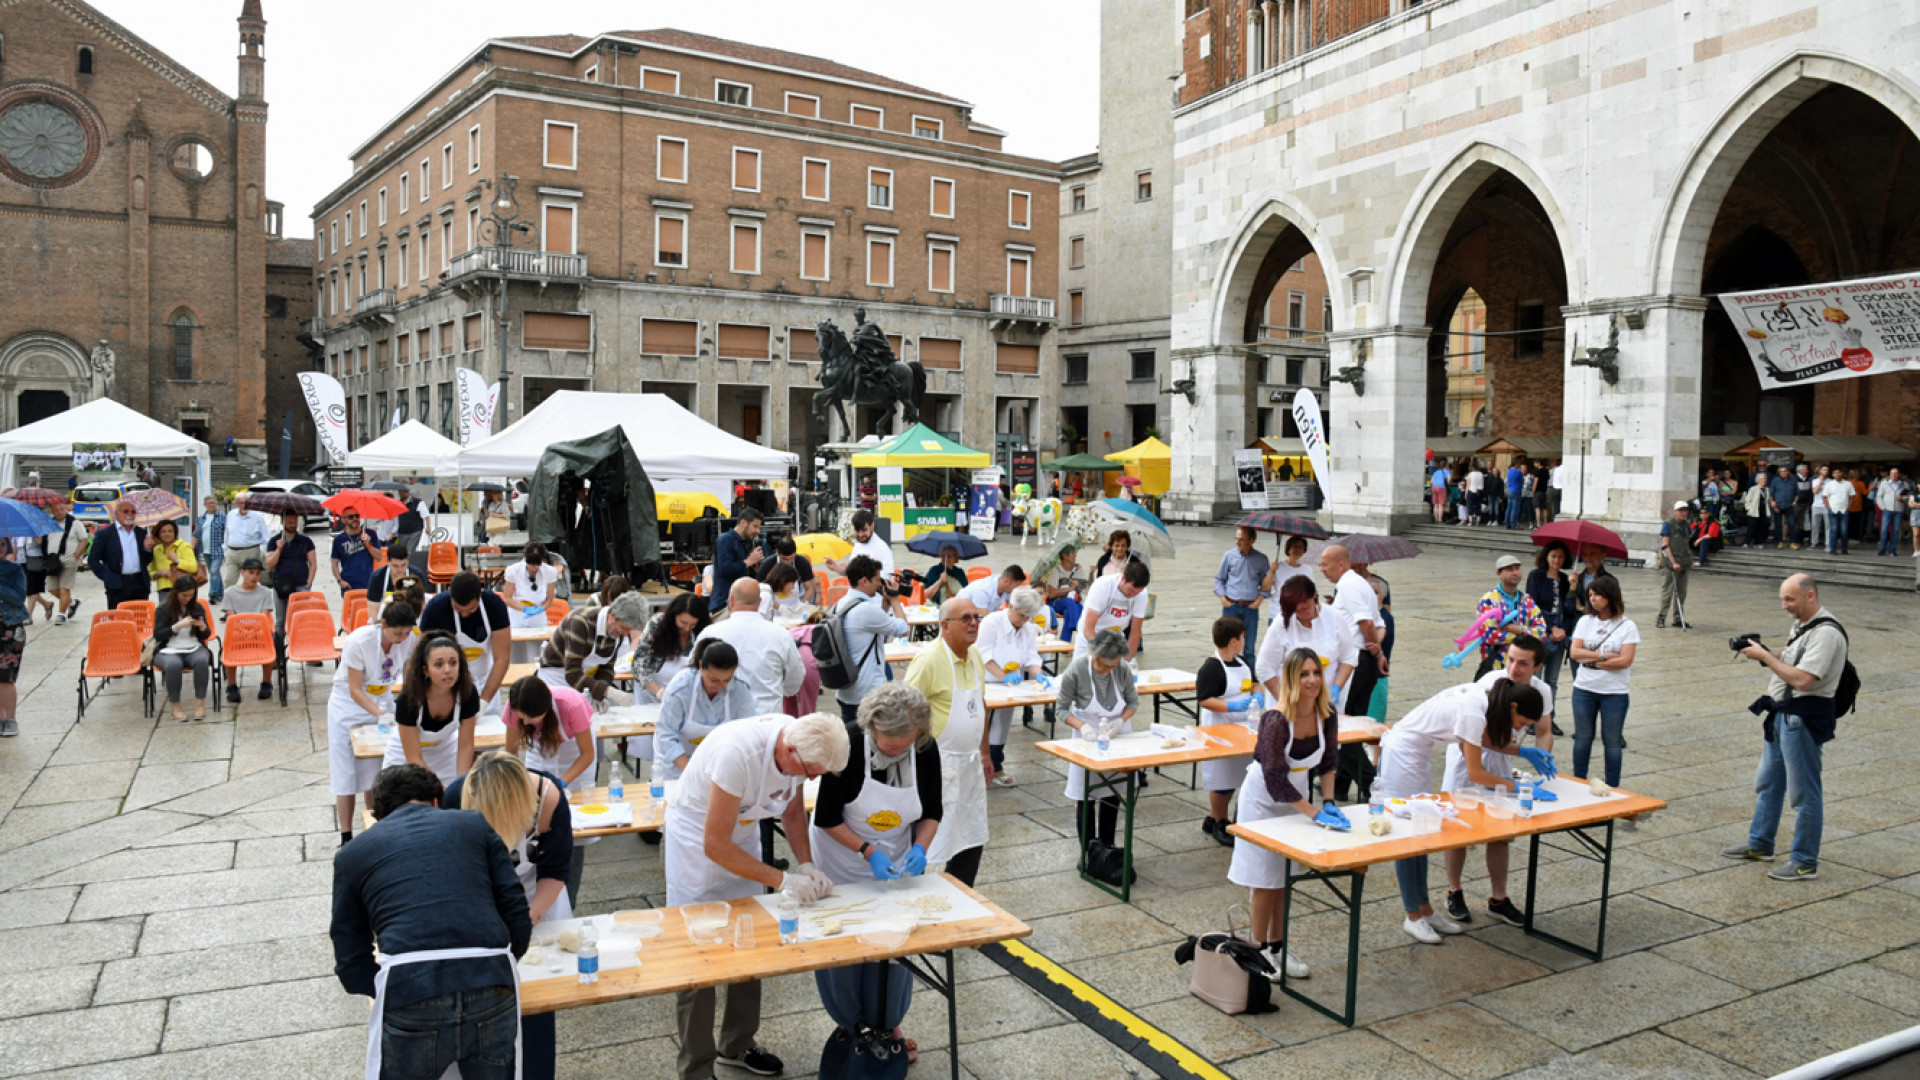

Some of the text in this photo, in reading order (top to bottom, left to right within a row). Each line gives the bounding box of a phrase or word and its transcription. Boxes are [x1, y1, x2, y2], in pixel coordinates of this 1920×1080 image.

[1734, 291, 1801, 304] PIACENZA
[1844, 281, 1906, 293] GIUGNO
[1852, 292, 1912, 302] COOKING
[1871, 309, 1909, 318] TALK
[1870, 317, 1916, 325] MERCATO
[1779, 341, 1839, 369] Festival
[1795, 362, 1839, 379] PIACENZA
[879, 494, 902, 502] SIVAM
[916, 516, 947, 526] SIVAM
